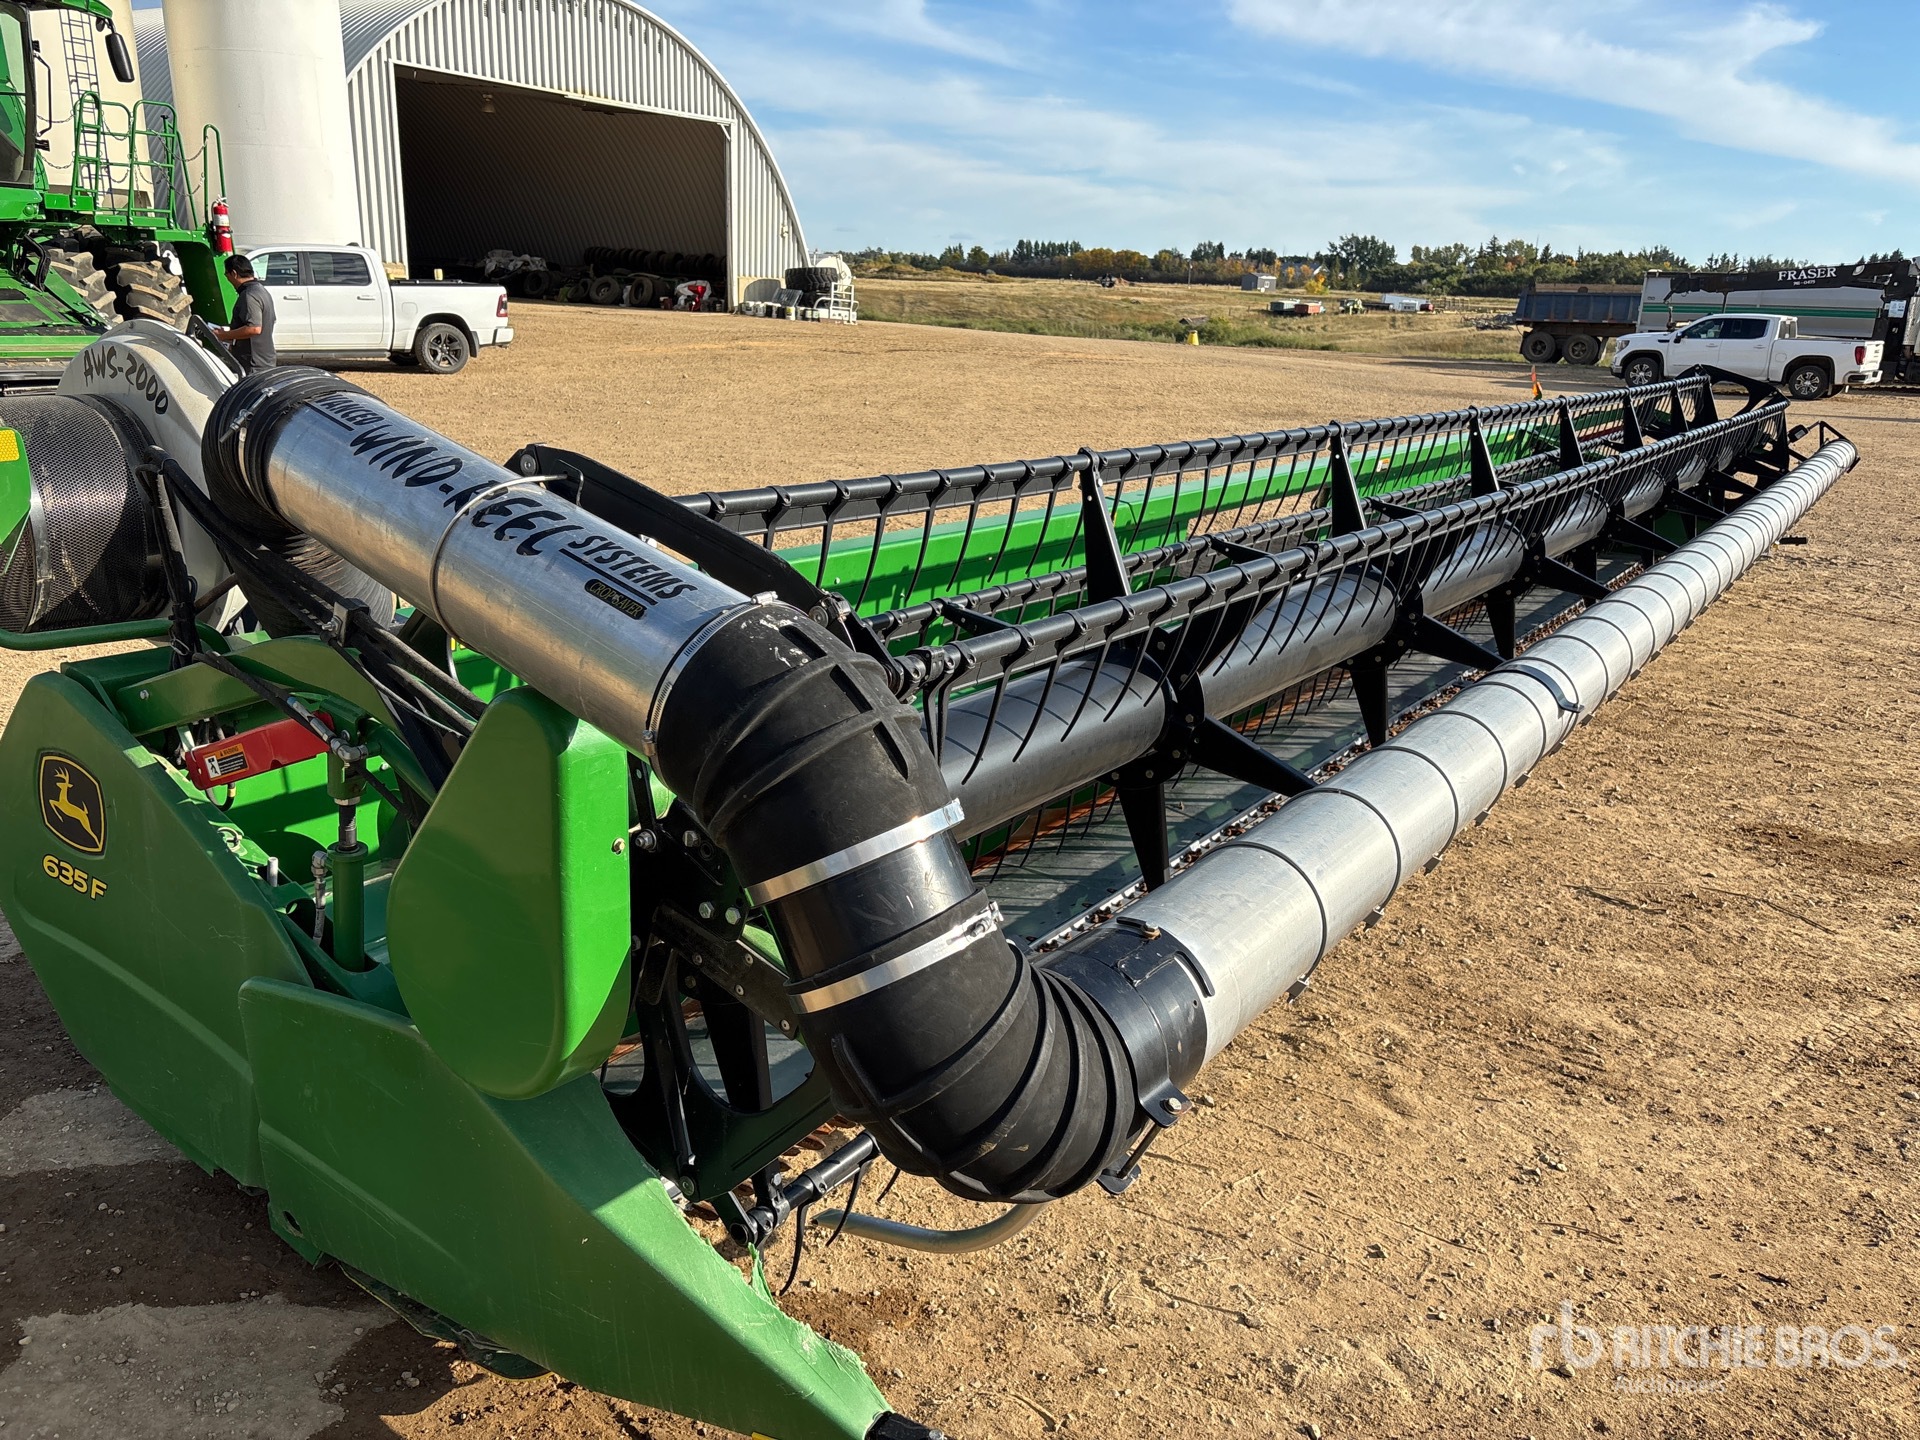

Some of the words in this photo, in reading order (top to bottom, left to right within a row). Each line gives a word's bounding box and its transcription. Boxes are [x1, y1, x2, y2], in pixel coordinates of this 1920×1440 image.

[1777, 267, 1837, 282] FRASER
[83, 345, 168, 414] AWS-2000
[567, 535, 698, 599] SYSTEMS
[613, 594, 643, 617] SAVER
